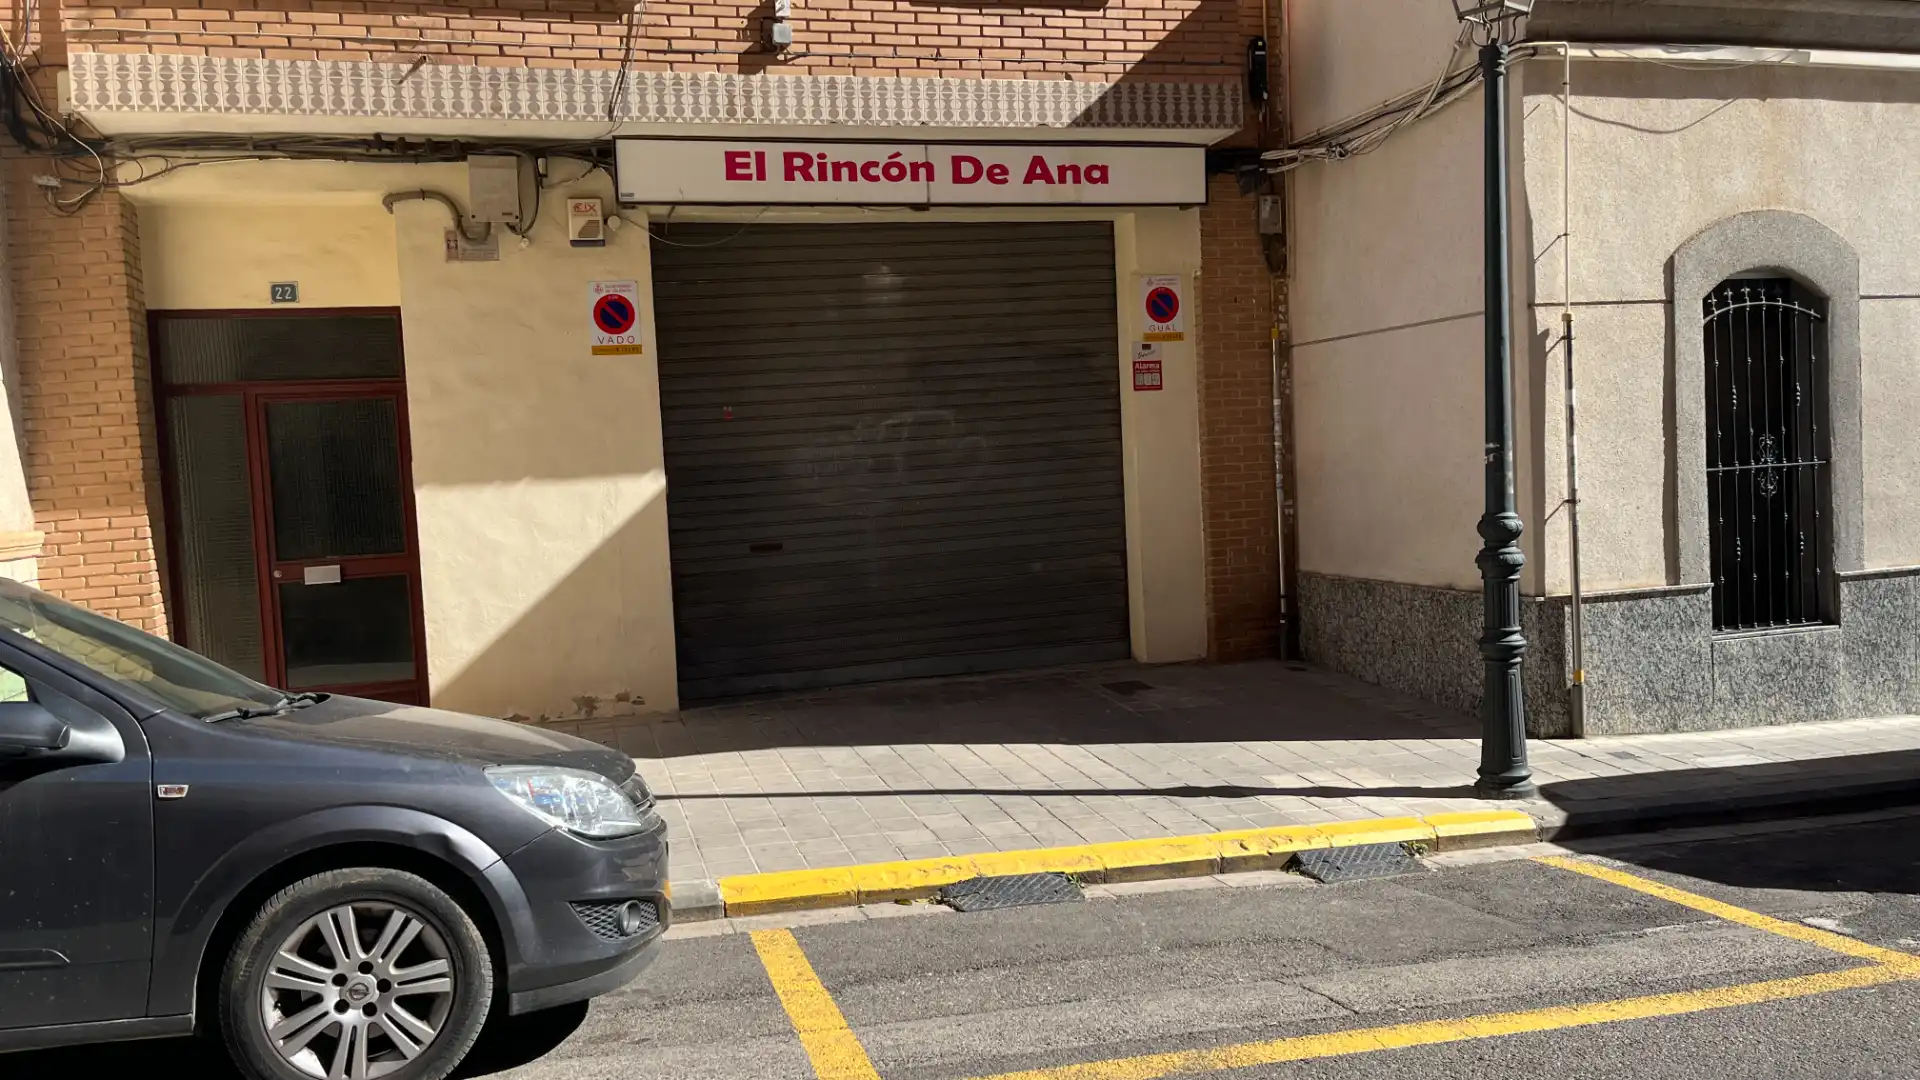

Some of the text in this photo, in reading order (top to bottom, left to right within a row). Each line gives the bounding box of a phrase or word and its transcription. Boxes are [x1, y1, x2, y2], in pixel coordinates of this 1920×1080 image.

[724, 151, 1110, 185] El Rincón De Ana
[275, 286, 293, 300] 22
[597, 335, 636, 345] VADO
[1135, 362, 1160, 370] Alarma
